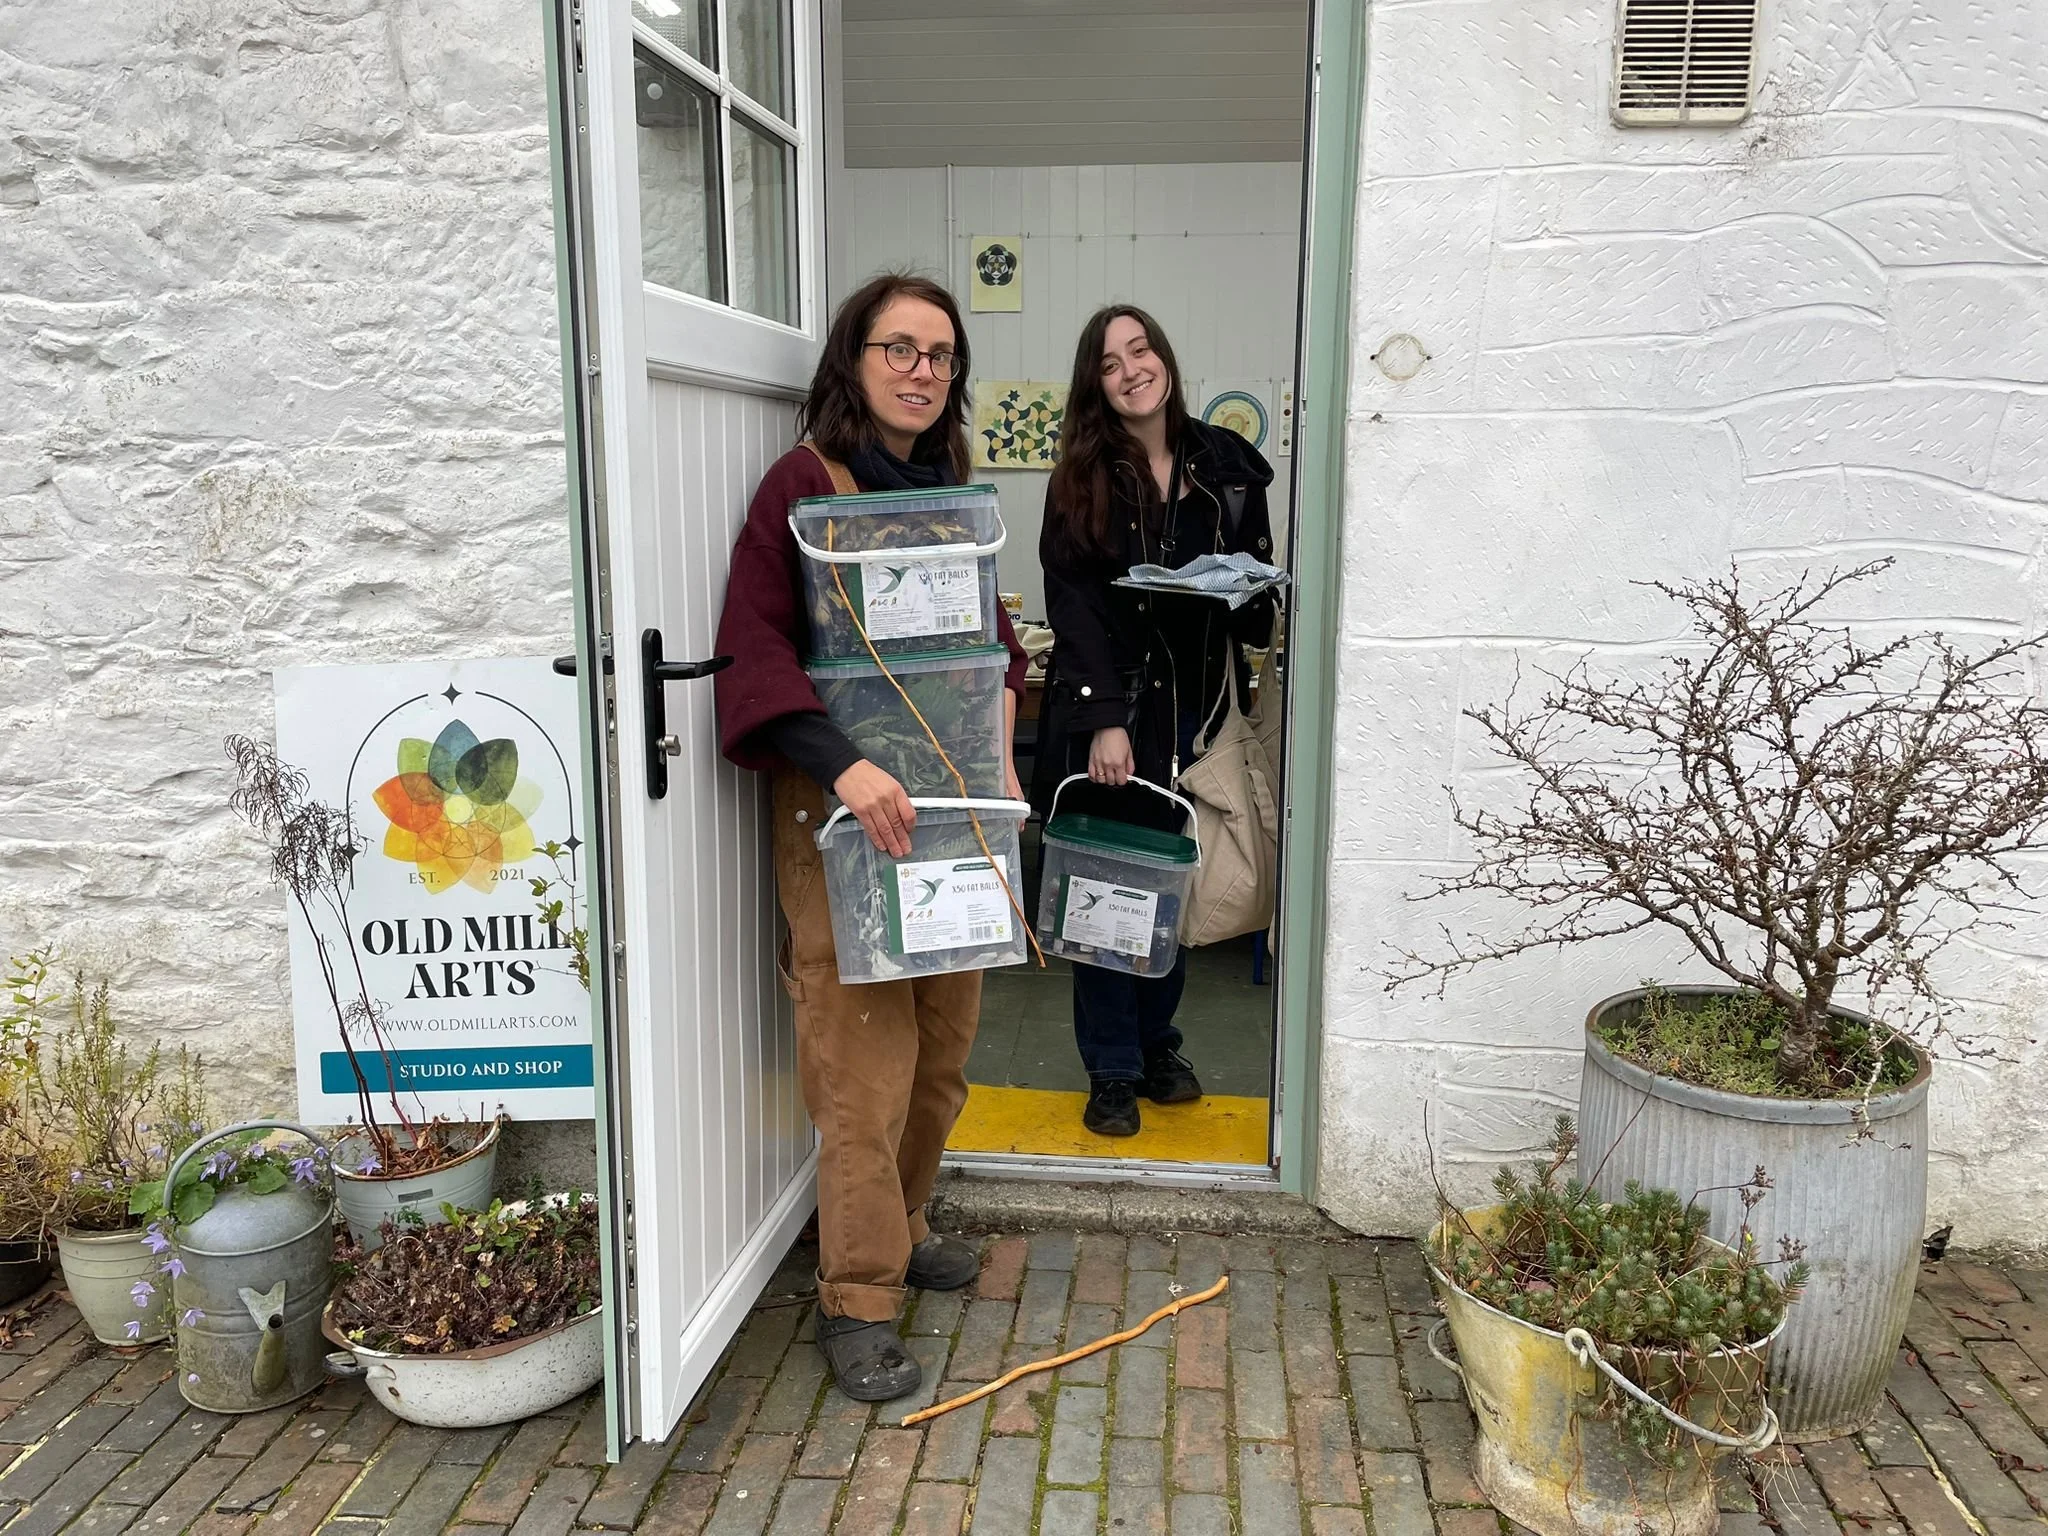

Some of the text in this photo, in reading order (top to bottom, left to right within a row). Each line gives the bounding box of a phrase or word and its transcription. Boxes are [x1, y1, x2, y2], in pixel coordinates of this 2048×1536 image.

[948, 569, 969, 579] BALLS
[408, 868, 525, 885] EST. 2021
[952, 881, 1000, 894] X50 FAT BALLS
[1131, 907, 1148, 917] BALLS
[362, 914, 573, 956] OLD MILL
[404, 959, 536, 1000] ARTS
[381, 1015, 578, 1032] WWW.OLDMILLARTS.COM
[400, 1060, 564, 1079] STUDIO AND SHOP
